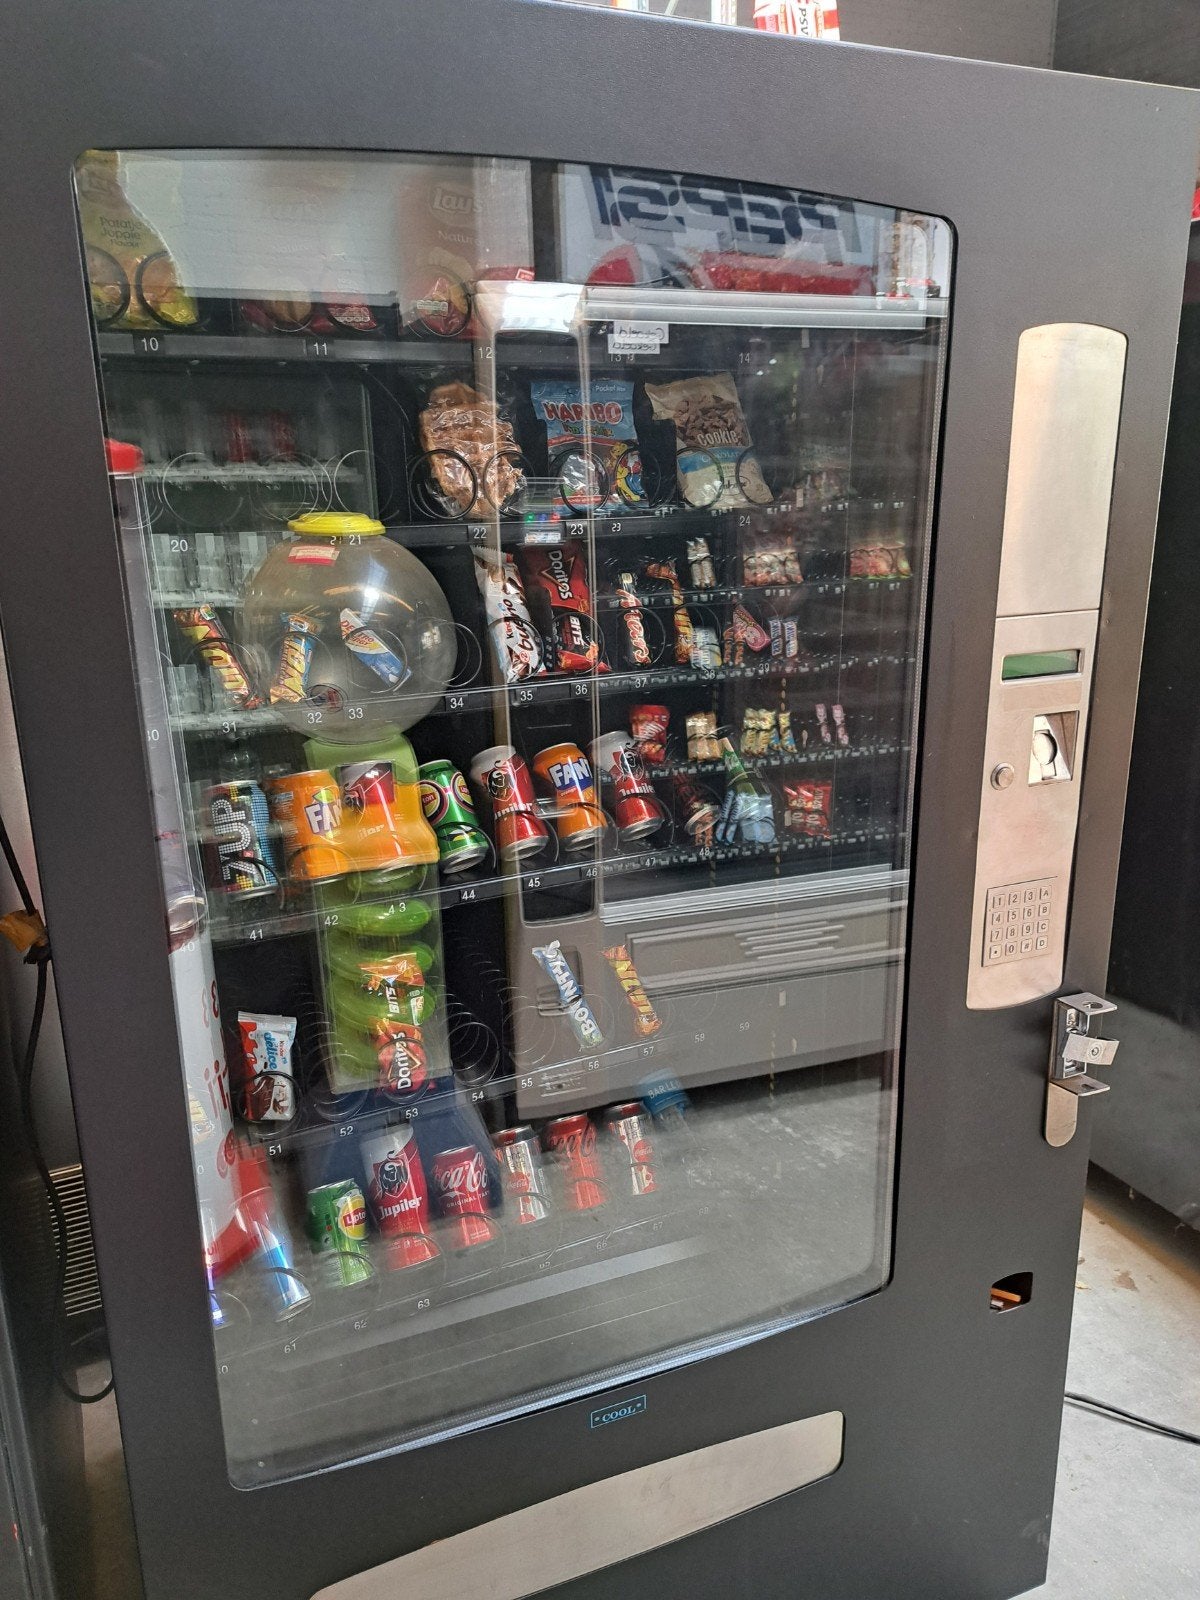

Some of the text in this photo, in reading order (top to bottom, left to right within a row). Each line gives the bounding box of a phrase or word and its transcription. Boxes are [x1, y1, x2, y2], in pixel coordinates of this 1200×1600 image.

[798, 7, 809, 36] PSV
[140, 338, 159, 353] 10
[313, 342, 329, 356] 11
[478, 346, 493, 359] 12
[739, 352, 751, 364] 14
[739, 515, 751, 527] 24
[473, 526, 487, 539] 22
[570, 523, 584, 535] 23
[170, 539, 188, 552] 20
[349, 534, 362, 546] 21
[549, 550, 573, 600] Doritos
[635, 677, 647, 688] 37
[575, 684, 588, 695] 36
[520, 690, 533, 702] 35
[450, 697, 464, 709] 34
[307, 712, 323, 724] 32
[348, 707, 363, 719] 33
[222, 722, 237, 734] 31
[644, 857, 657, 868] 47
[586, 867, 598, 878] 46
[528, 877, 541, 888] 45
[462, 889, 476, 901] 44
[997, 897, 1002, 906] 1
[1012, 894, 1018, 903] 2
[1027, 891, 1034, 901] 3
[324, 914, 339, 926] 42
[995, 906, 1048, 923] 4 5 6 B
[249, 928, 264, 941] 41
[994, 931, 1000, 940] 7
[1009, 928, 1015, 937] 8
[1025, 925, 1031, 934] 9
[1008, 944, 1015, 953] 0
[694, 1032, 706, 1043] 58
[643, 1046, 655, 1057] 57
[588, 1060, 600, 1071] 56
[521, 1078, 534, 1088] 55
[471, 1090, 485, 1102] 54
[405, 1108, 419, 1119] 53
[339, 1126, 354, 1137] 52
[268, 1143, 283, 1156] 51
[380, 1196, 422, 1220] Jupiler
[417, 1298, 430, 1310] 63
[284, 1342, 297, 1354] 61
[602, 1405, 636, 1422] COOL
